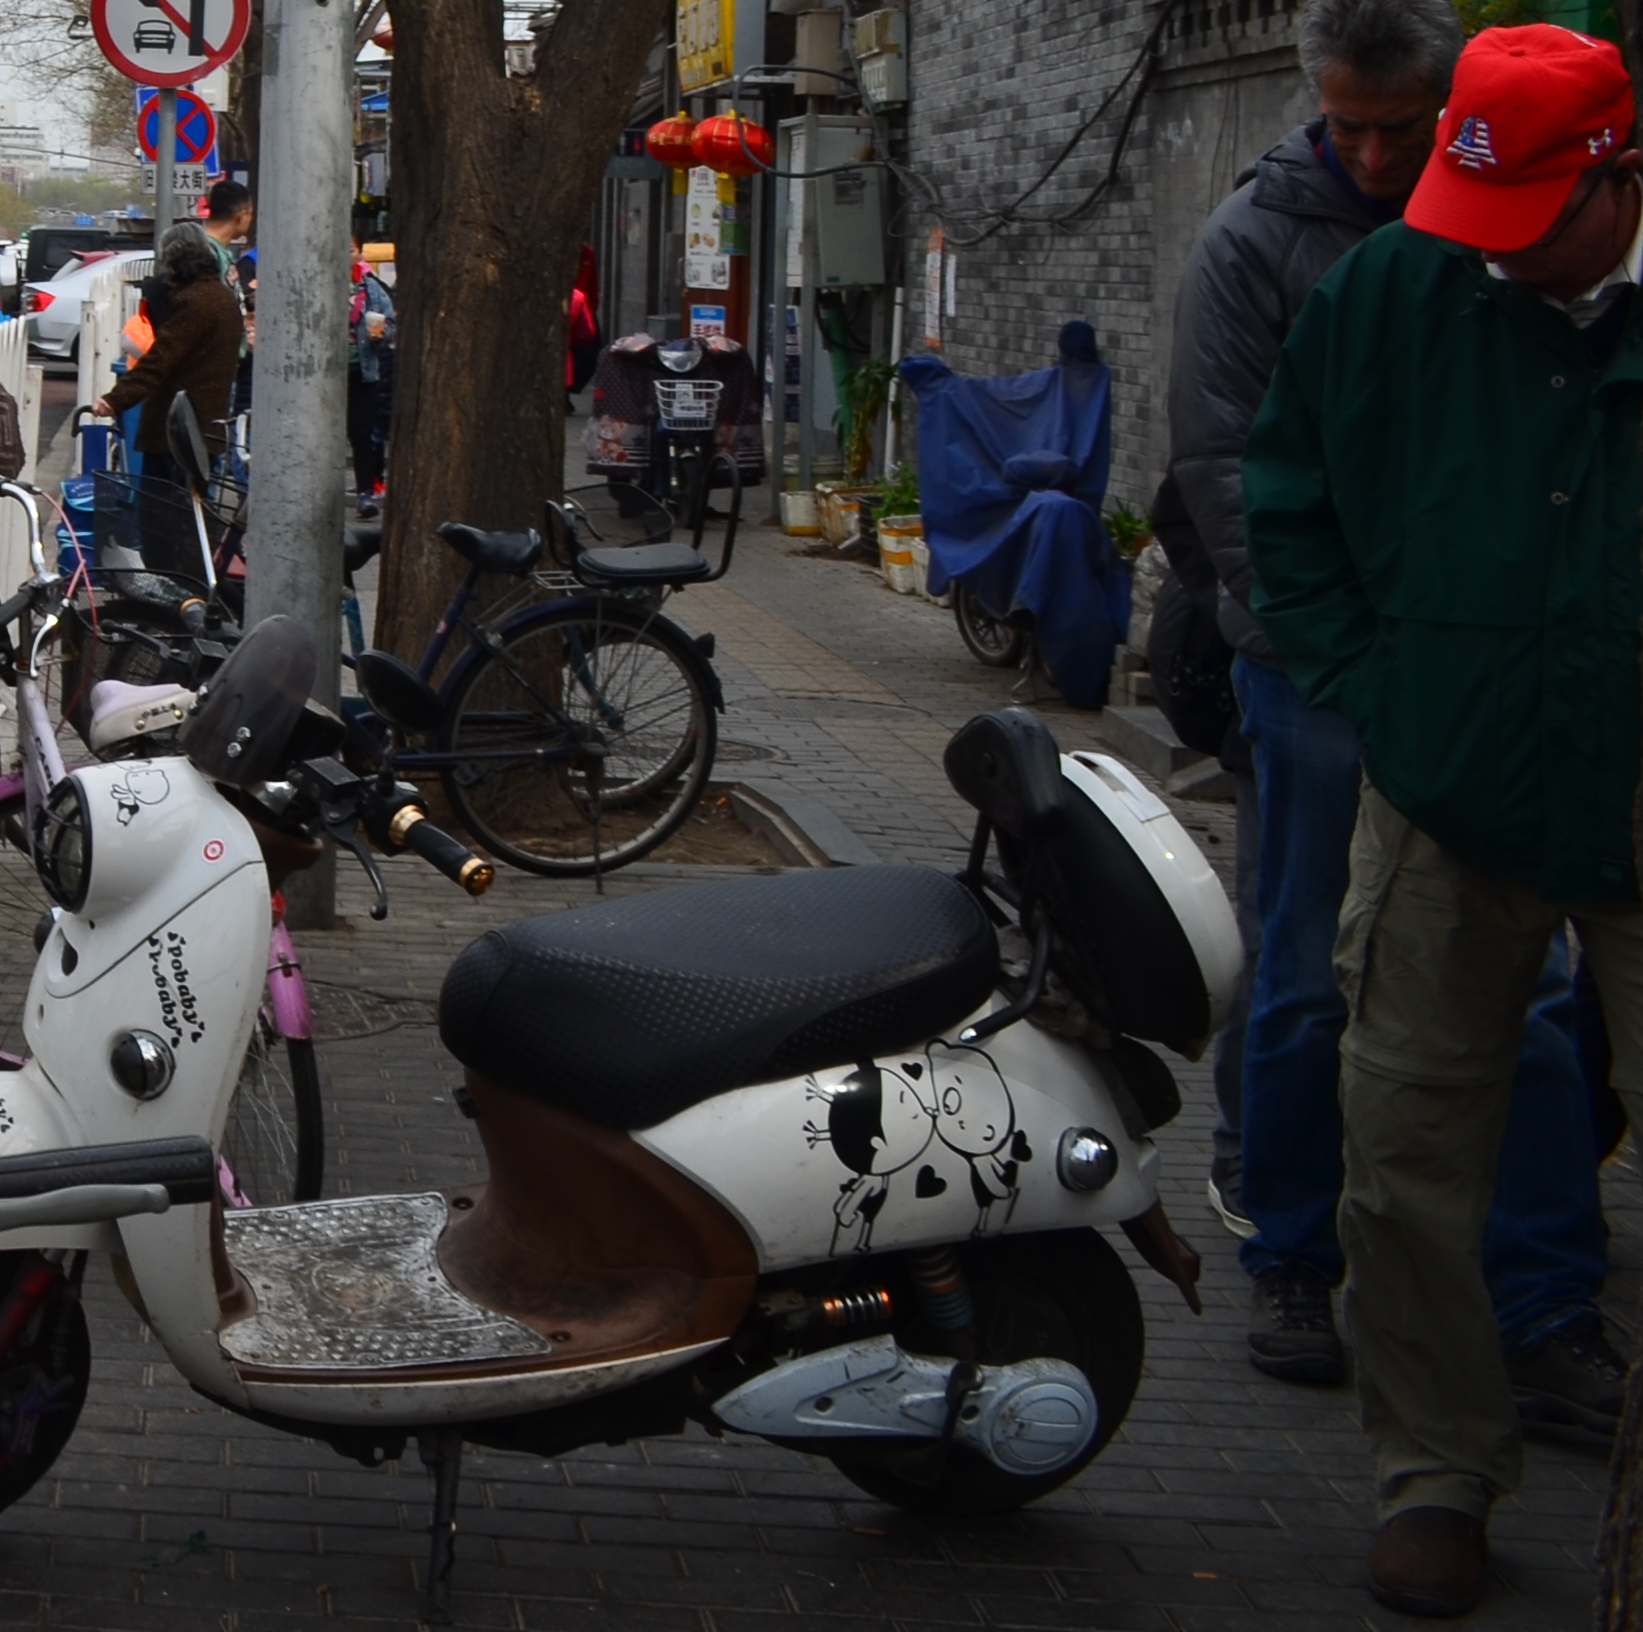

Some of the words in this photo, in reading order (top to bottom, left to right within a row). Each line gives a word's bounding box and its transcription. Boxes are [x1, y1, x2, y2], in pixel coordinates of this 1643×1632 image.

[145, 169, 203, 189] 旧大街
[167, 944, 198, 1025] pobaby
